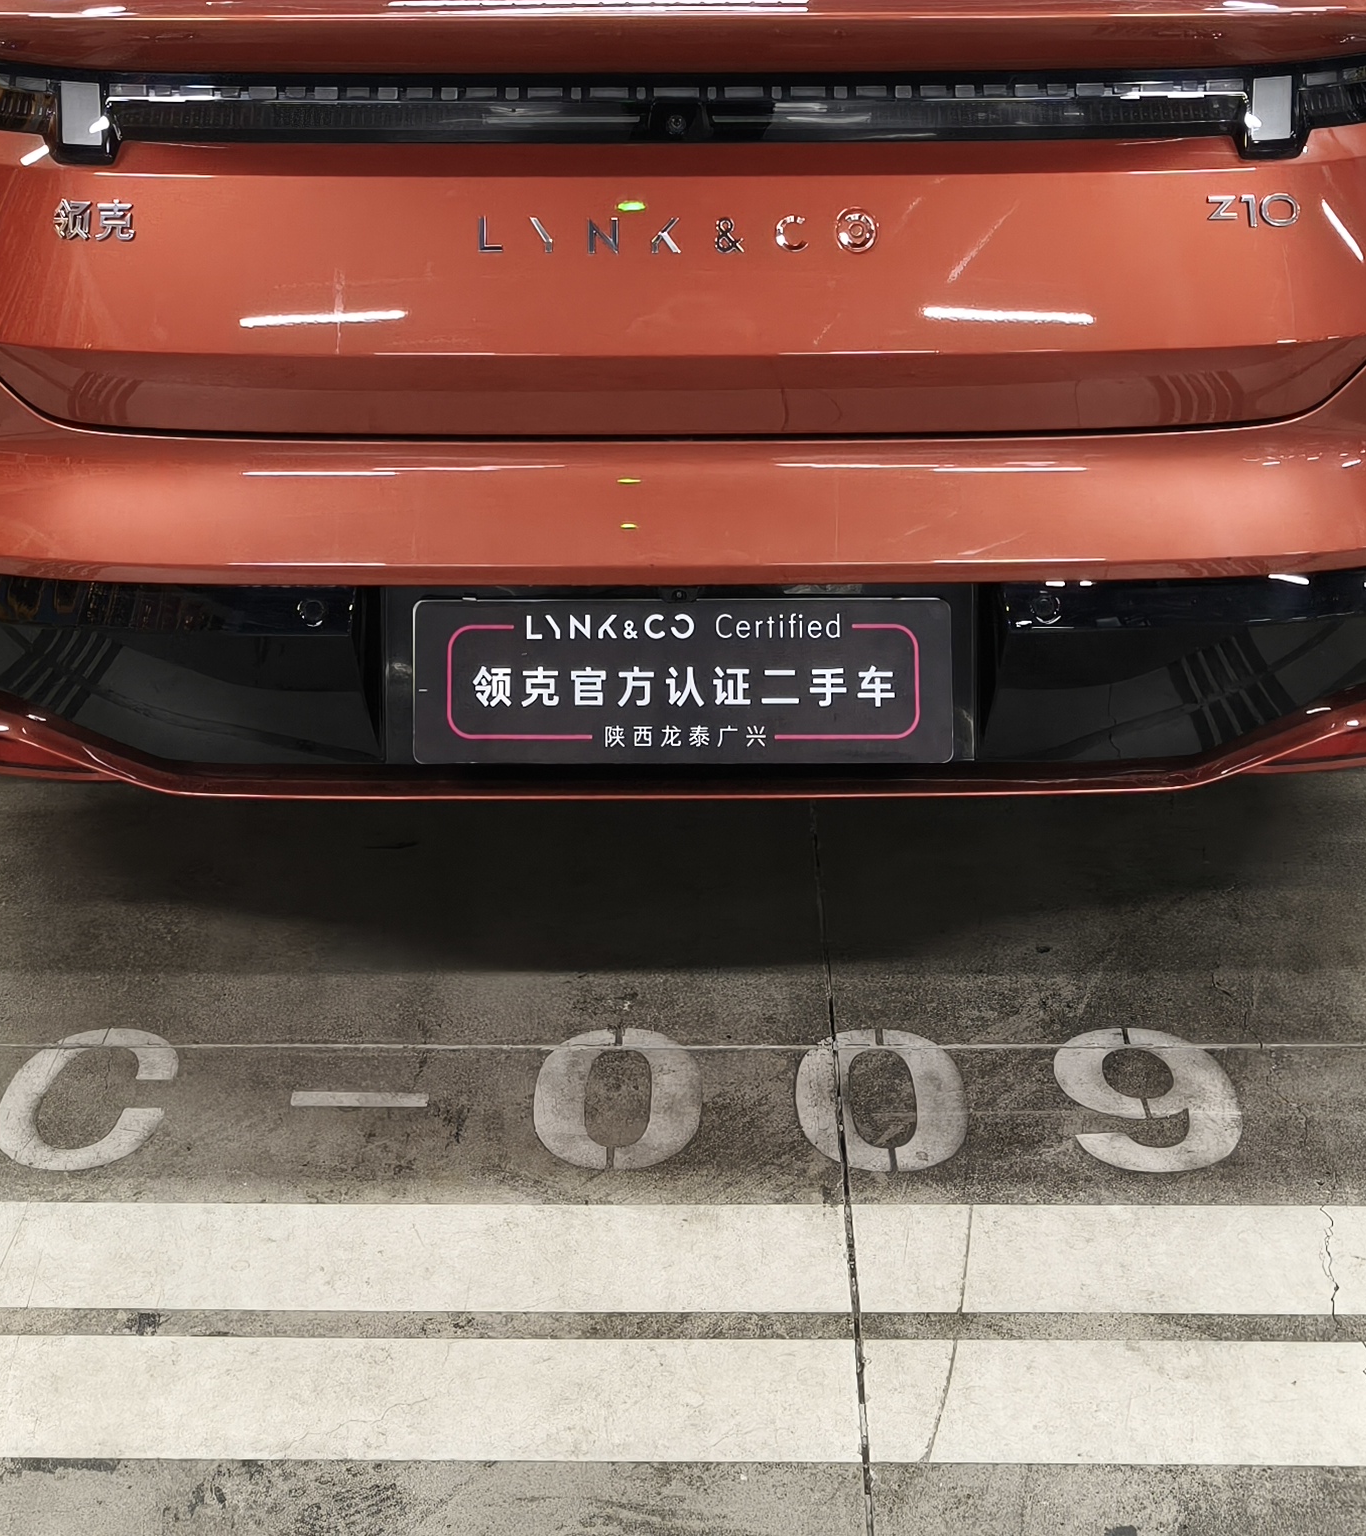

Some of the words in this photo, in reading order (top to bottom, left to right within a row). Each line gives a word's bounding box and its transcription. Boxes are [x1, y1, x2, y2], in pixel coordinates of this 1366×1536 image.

[53, 198, 137, 242] 领克
[477, 205, 881, 254] LYNK&CO
[1206, 192, 1301, 228] Z10
[525, 613, 696, 641] LYNK&CO
[714, 613, 842, 640] Certified
[472, 665, 898, 708] 领克官方认证二手车
[604, 725, 768, 749] 陕西龙泰广兴
